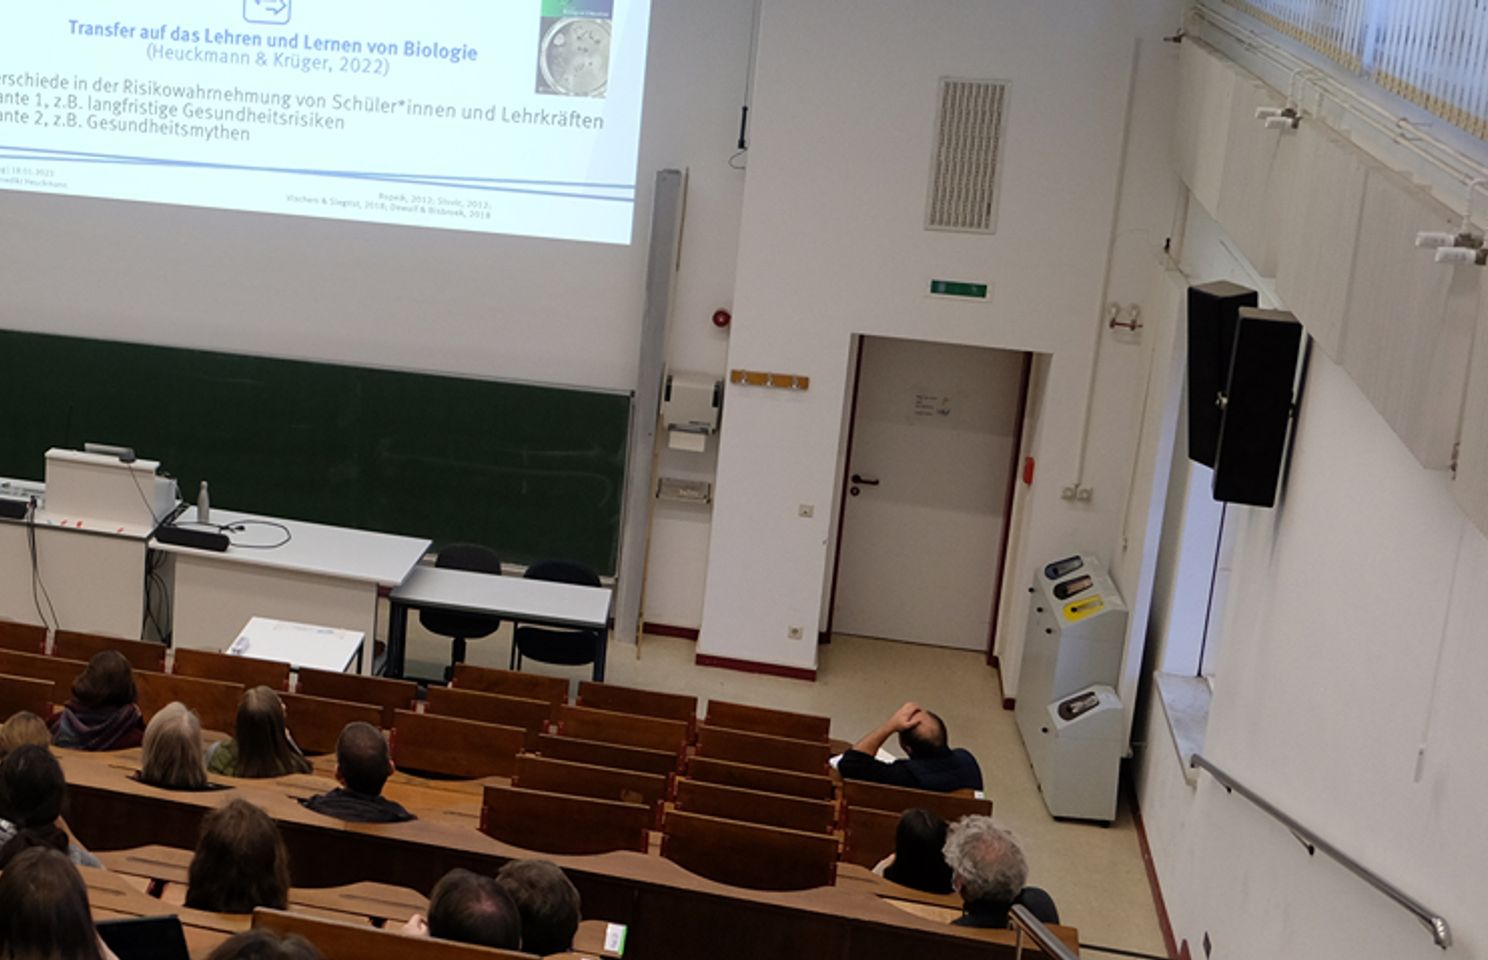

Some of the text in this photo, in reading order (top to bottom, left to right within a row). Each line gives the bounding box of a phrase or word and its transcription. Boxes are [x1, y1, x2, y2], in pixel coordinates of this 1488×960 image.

[68, 19, 478, 63] Transfer auf das Lehren und Lernen von Biologie
[146, 42, 390, 77] (Heuckmann & Krüger, 2022)
[35, 92, 49, 109] 1,
[54, 95, 82, 110] z.B.
[88, 95, 178, 121] langfristige
[183, 104, 345, 130] Gesundheitsrisiken
[73, 75, 88, 92] in
[93, 75, 119, 94] der
[123, 79, 291, 109] Risikowahrnehmung
[296, 94, 326, 109] von
[462, 102, 495, 122] und
[502, 106, 605, 130] Lehrkräften
[34, 111, 49, 128] 2,
[53, 112, 83, 128] z.B.
[87, 114, 251, 142] Gesundheitsmythen
